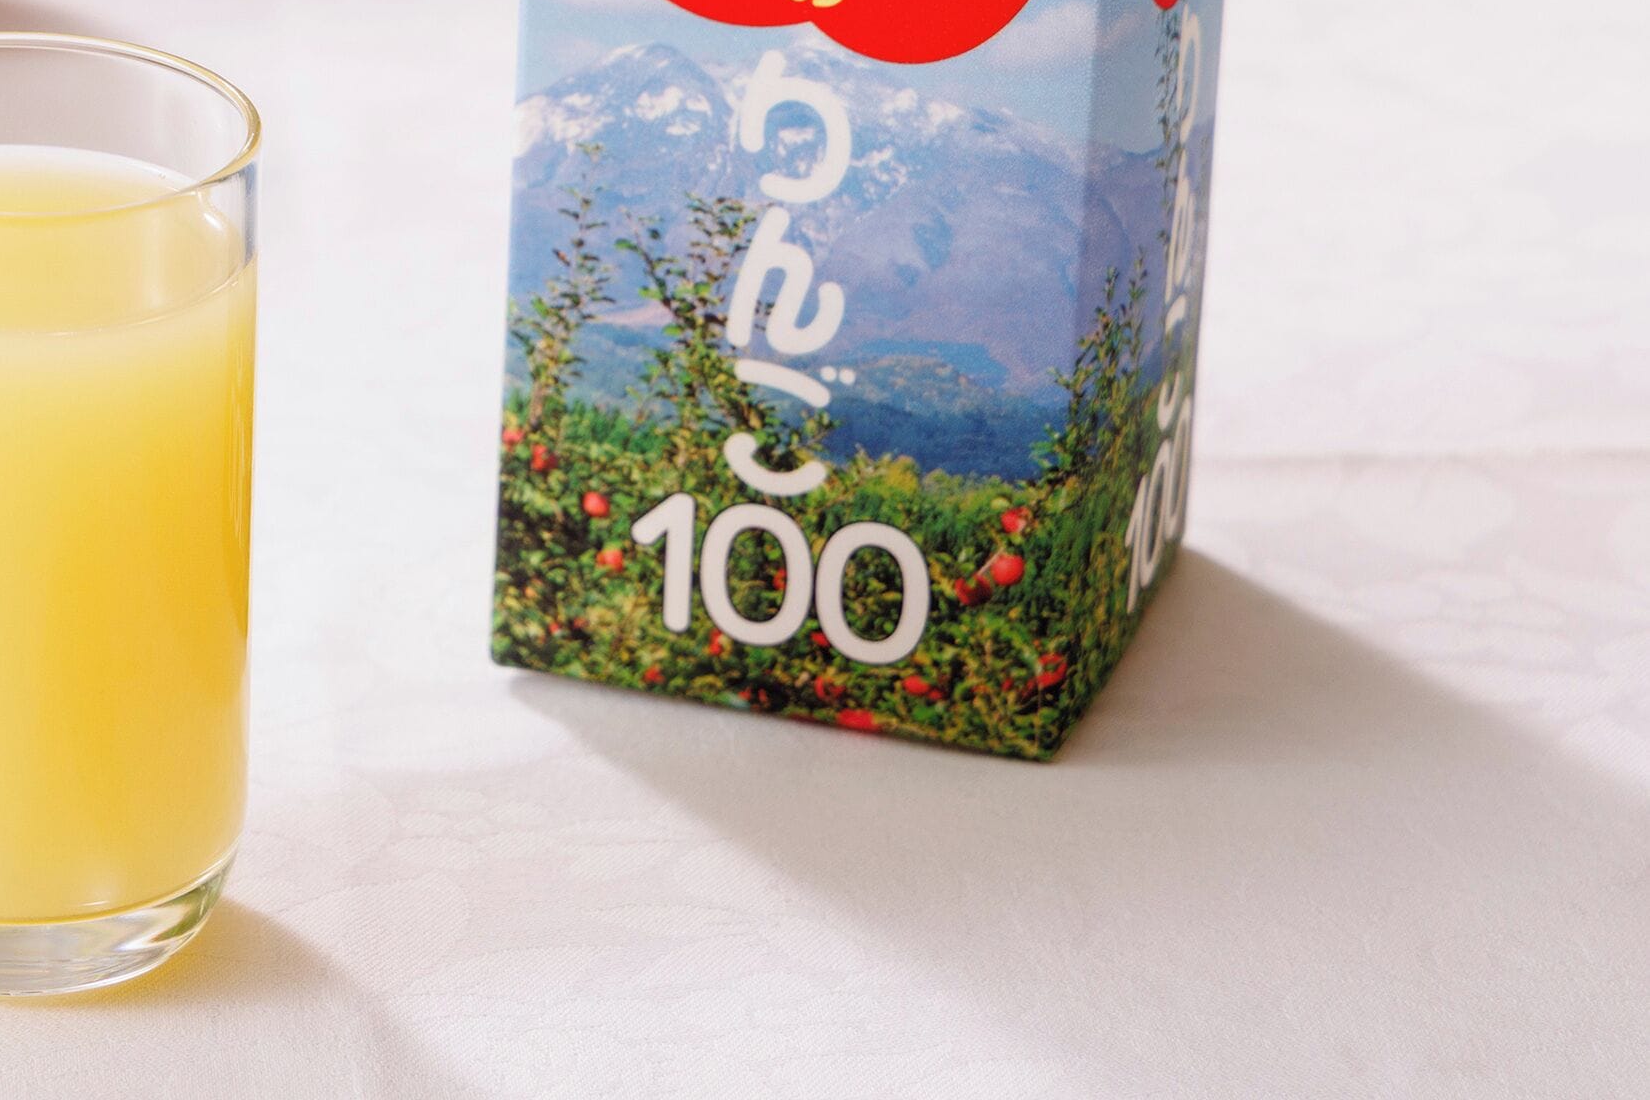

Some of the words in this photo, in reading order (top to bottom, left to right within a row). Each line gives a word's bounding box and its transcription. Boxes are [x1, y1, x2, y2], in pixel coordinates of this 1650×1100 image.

[722, 48, 857, 498] りんご
[630, 492, 931, 668] 100
[1125, 394, 1192, 615] 100
